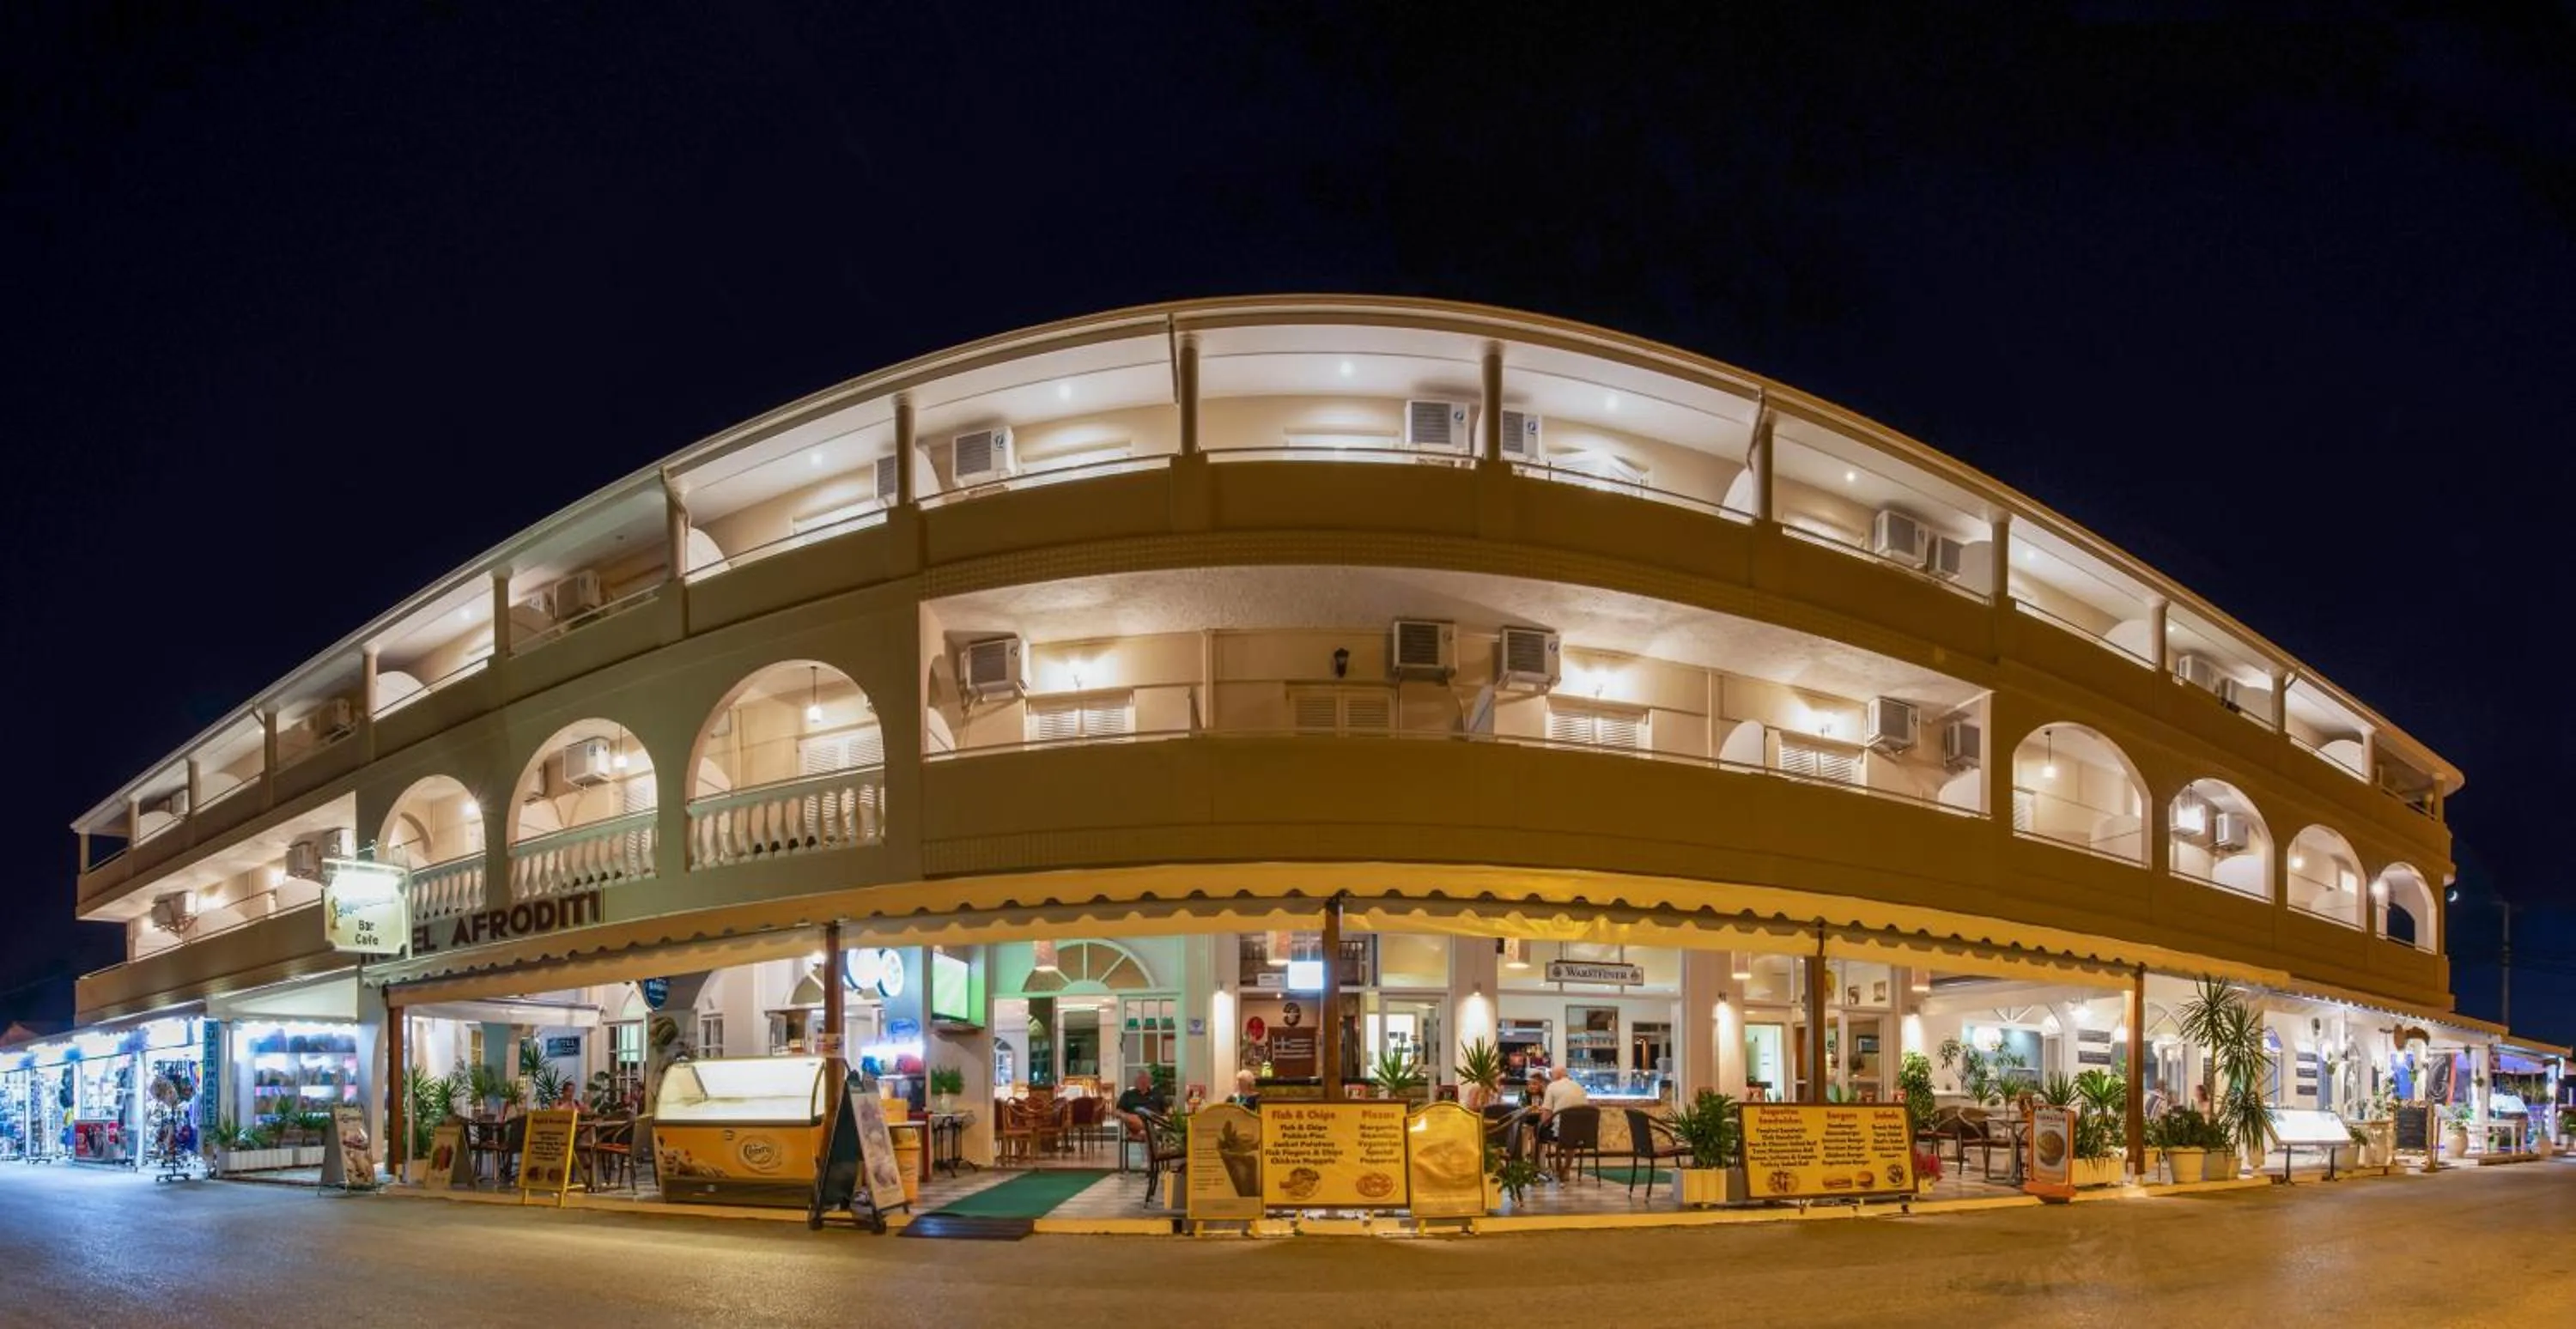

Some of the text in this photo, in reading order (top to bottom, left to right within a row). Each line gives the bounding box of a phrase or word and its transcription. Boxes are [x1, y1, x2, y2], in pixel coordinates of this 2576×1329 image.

[451, 890, 600, 946] AFRODITI
[358, 919, 375, 931] Bar
[1272, 1110, 1293, 1120] Fish
[1307, 1110, 1335, 1121] Chips
